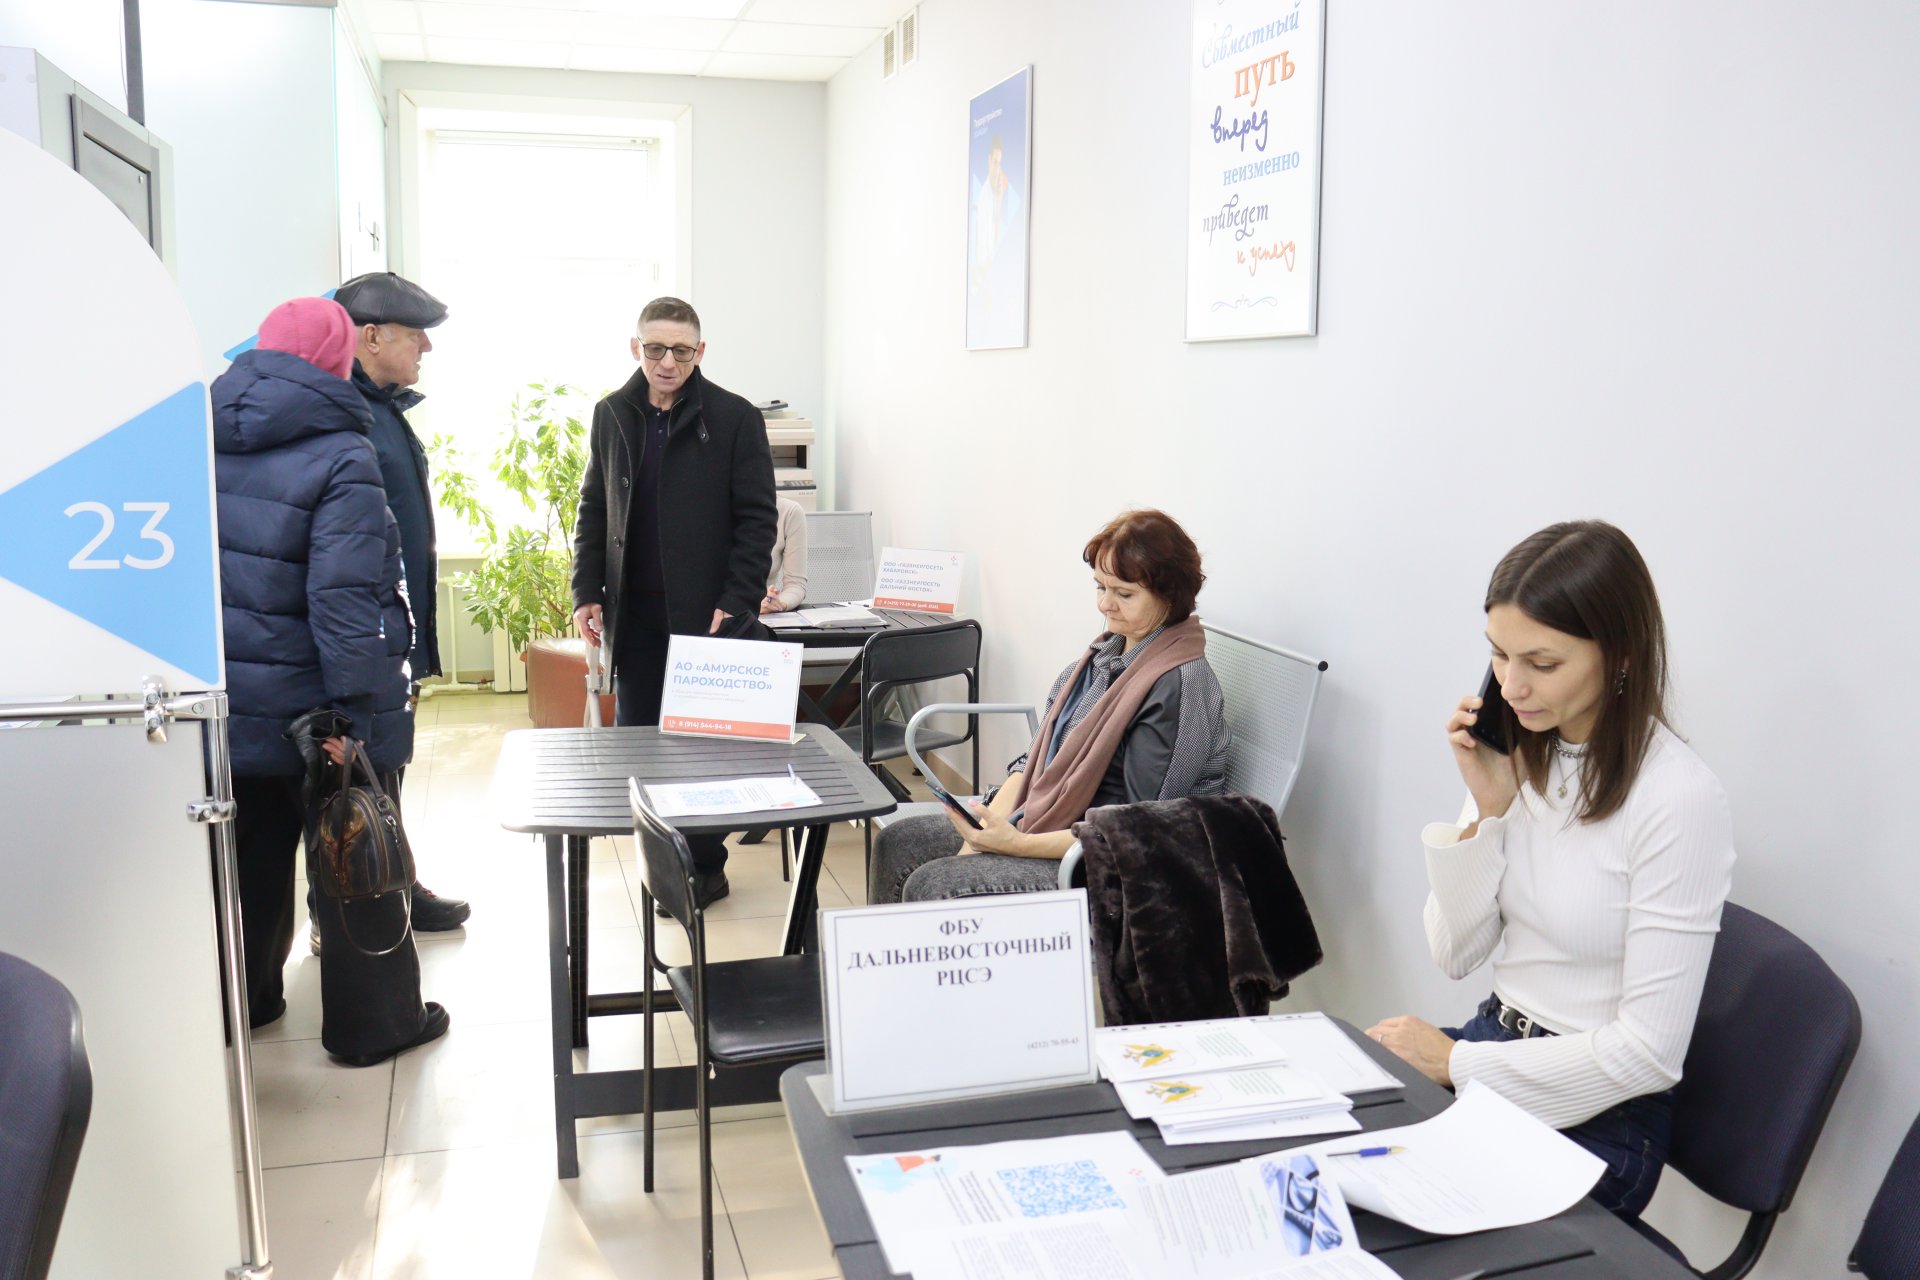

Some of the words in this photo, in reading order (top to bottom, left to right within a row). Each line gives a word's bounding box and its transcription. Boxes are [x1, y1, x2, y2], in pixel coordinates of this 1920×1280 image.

[1202, 0, 1301, 68] Совместный
[1210, 105, 1268, 151] вперед
[1223, 152, 1299, 186] неизменно
[1202, 193, 1269, 246] приведет
[1237, 250, 1245, 264] к
[1249, 240, 1296, 277] успеху
[64, 501, 175, 570] 23
[673, 675, 772, 690] ПАРОХОДСТВО»
[675, 662, 692, 671] АО
[696, 663, 770, 676] «АМУРСКОЕ
[939, 918, 984, 936] ФБУ
[847, 931, 1072, 970] ДАЛЬНЕВОСТОЧНЫЙ
[937, 967, 992, 987] РЦСЭ
